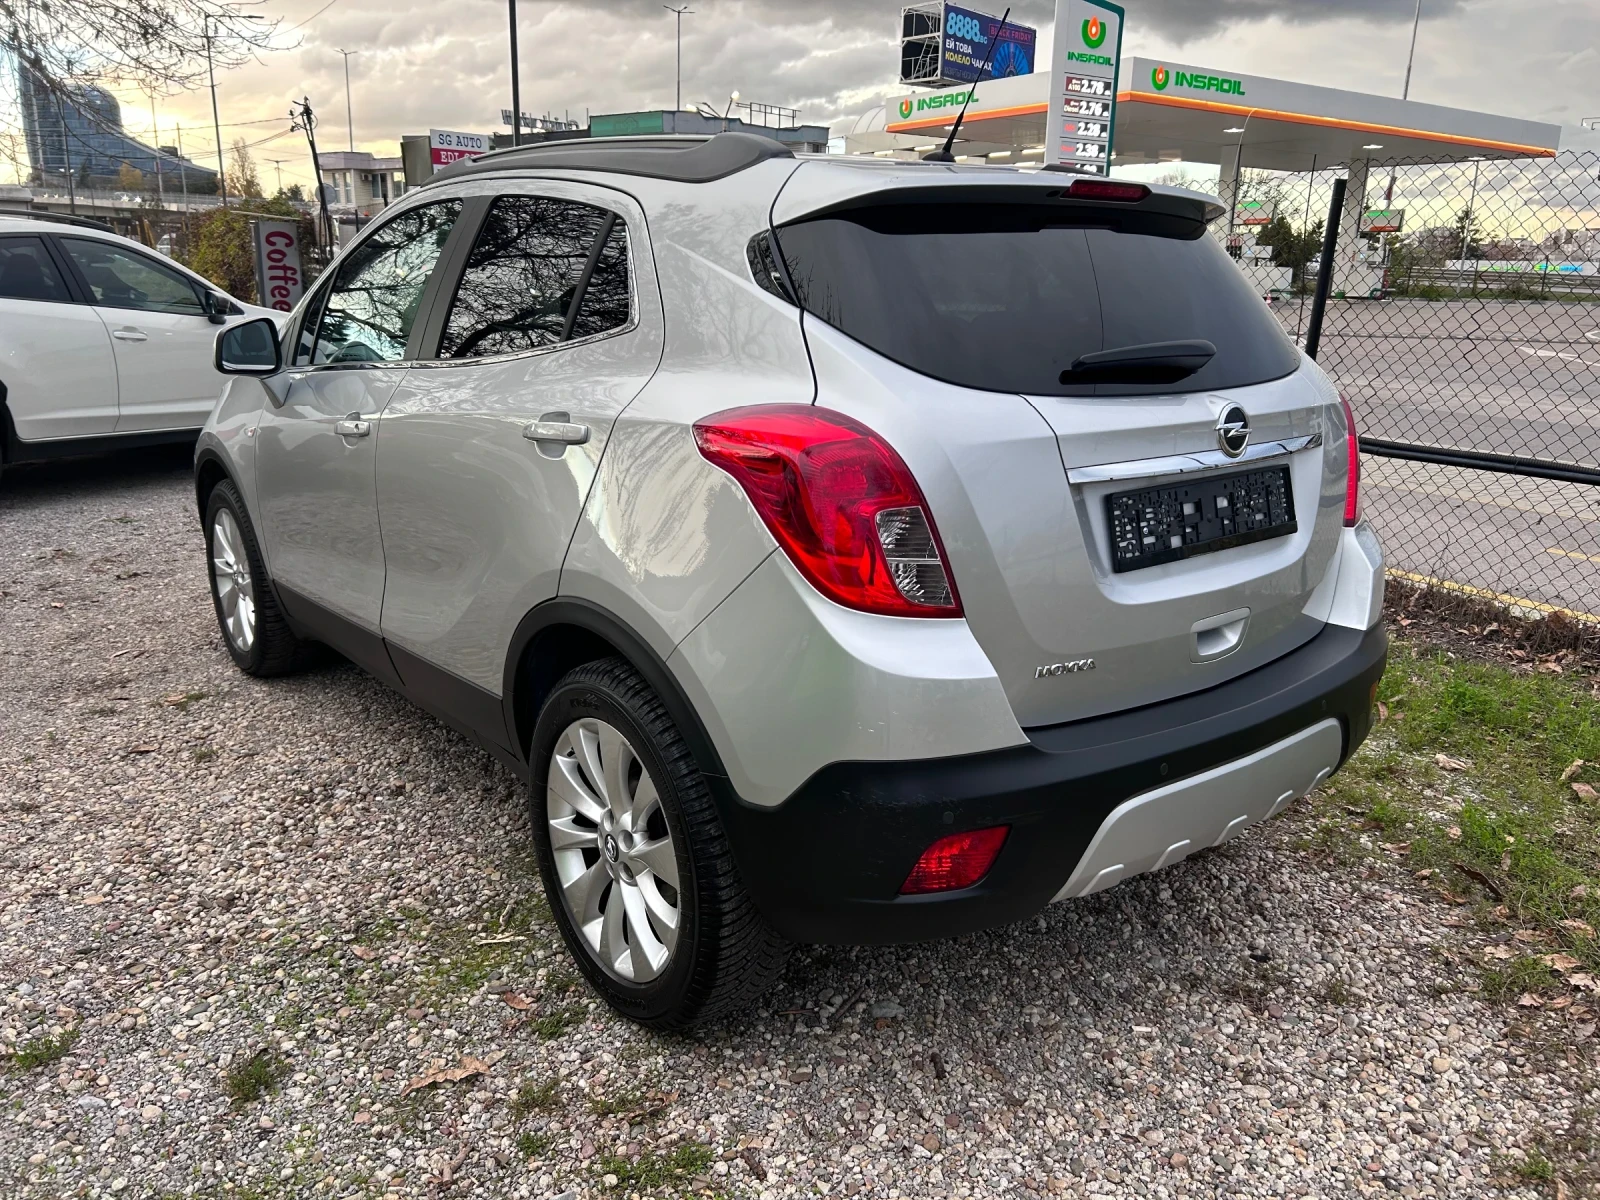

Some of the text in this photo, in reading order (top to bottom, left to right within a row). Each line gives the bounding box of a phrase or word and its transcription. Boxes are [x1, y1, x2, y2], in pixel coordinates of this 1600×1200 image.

[945, 38, 973, 55] ЕЙ ТОВА
[945, 51, 971, 66] КОЛЕЛО
[1067, 51, 1114, 66] INSAOIL
[1174, 71, 1246, 96] INSAOIL
[438, 133, 482, 149] SG AUTO
[265, 230, 299, 313] Coffee
[1034, 658, 1097, 679] MOKKA
